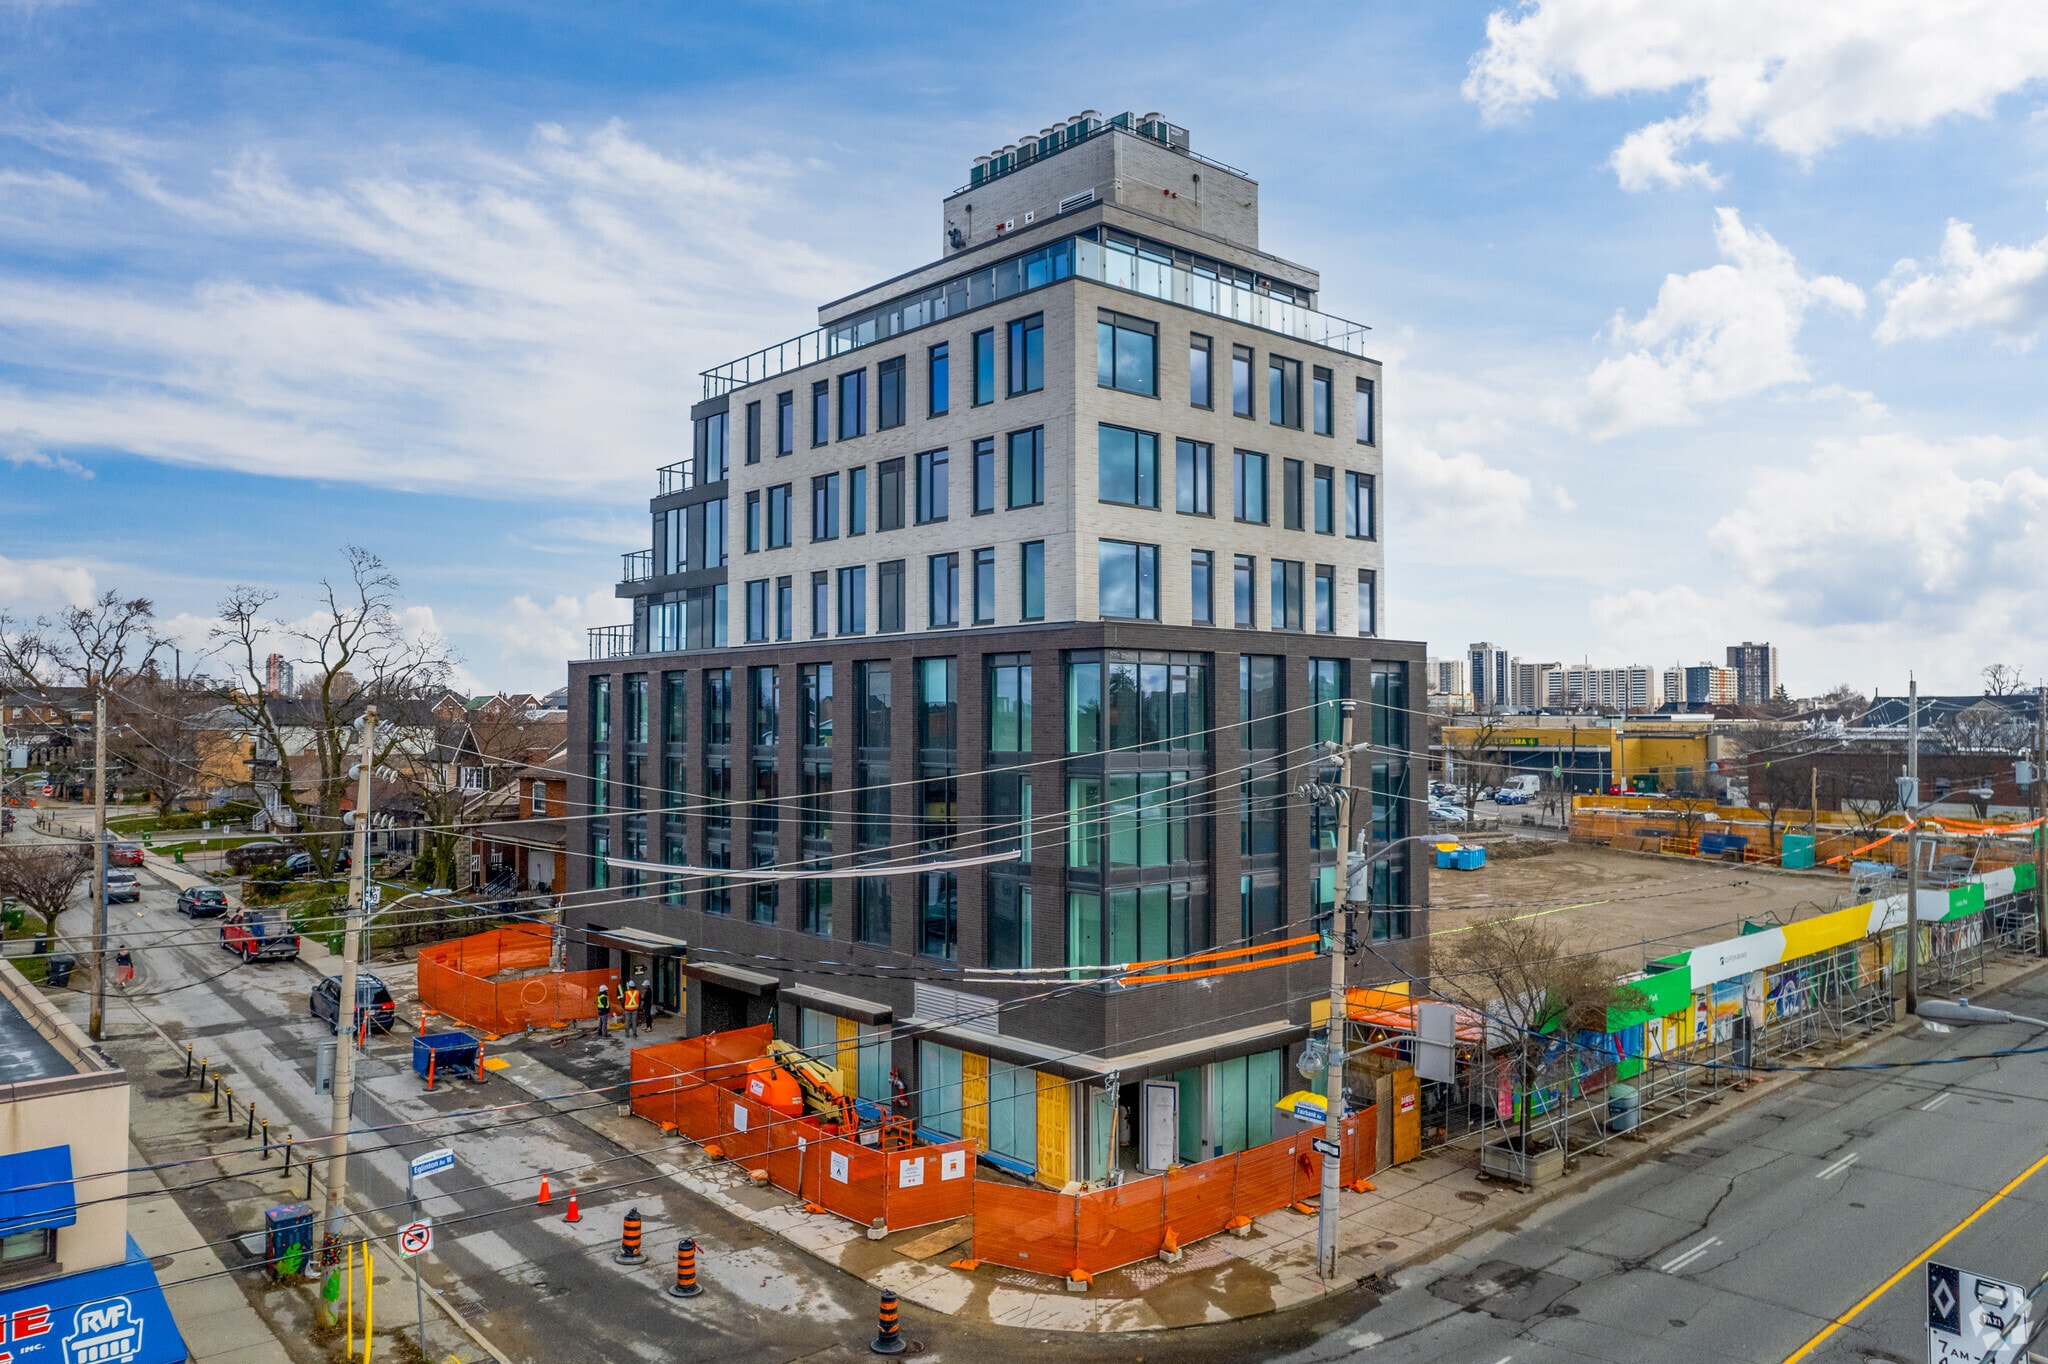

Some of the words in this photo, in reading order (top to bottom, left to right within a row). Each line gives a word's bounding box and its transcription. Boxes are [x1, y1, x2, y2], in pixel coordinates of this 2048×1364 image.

[1297, 1108, 1316, 1118] Fairbank
[414, 1160, 438, 1174] Eglinton
[0, 1304, 54, 1345] E
[81, 1303, 125, 1334] RVF
[1980, 1314, 2001, 1328] TAXI
[20, 1343, 45, 1354] INC.
